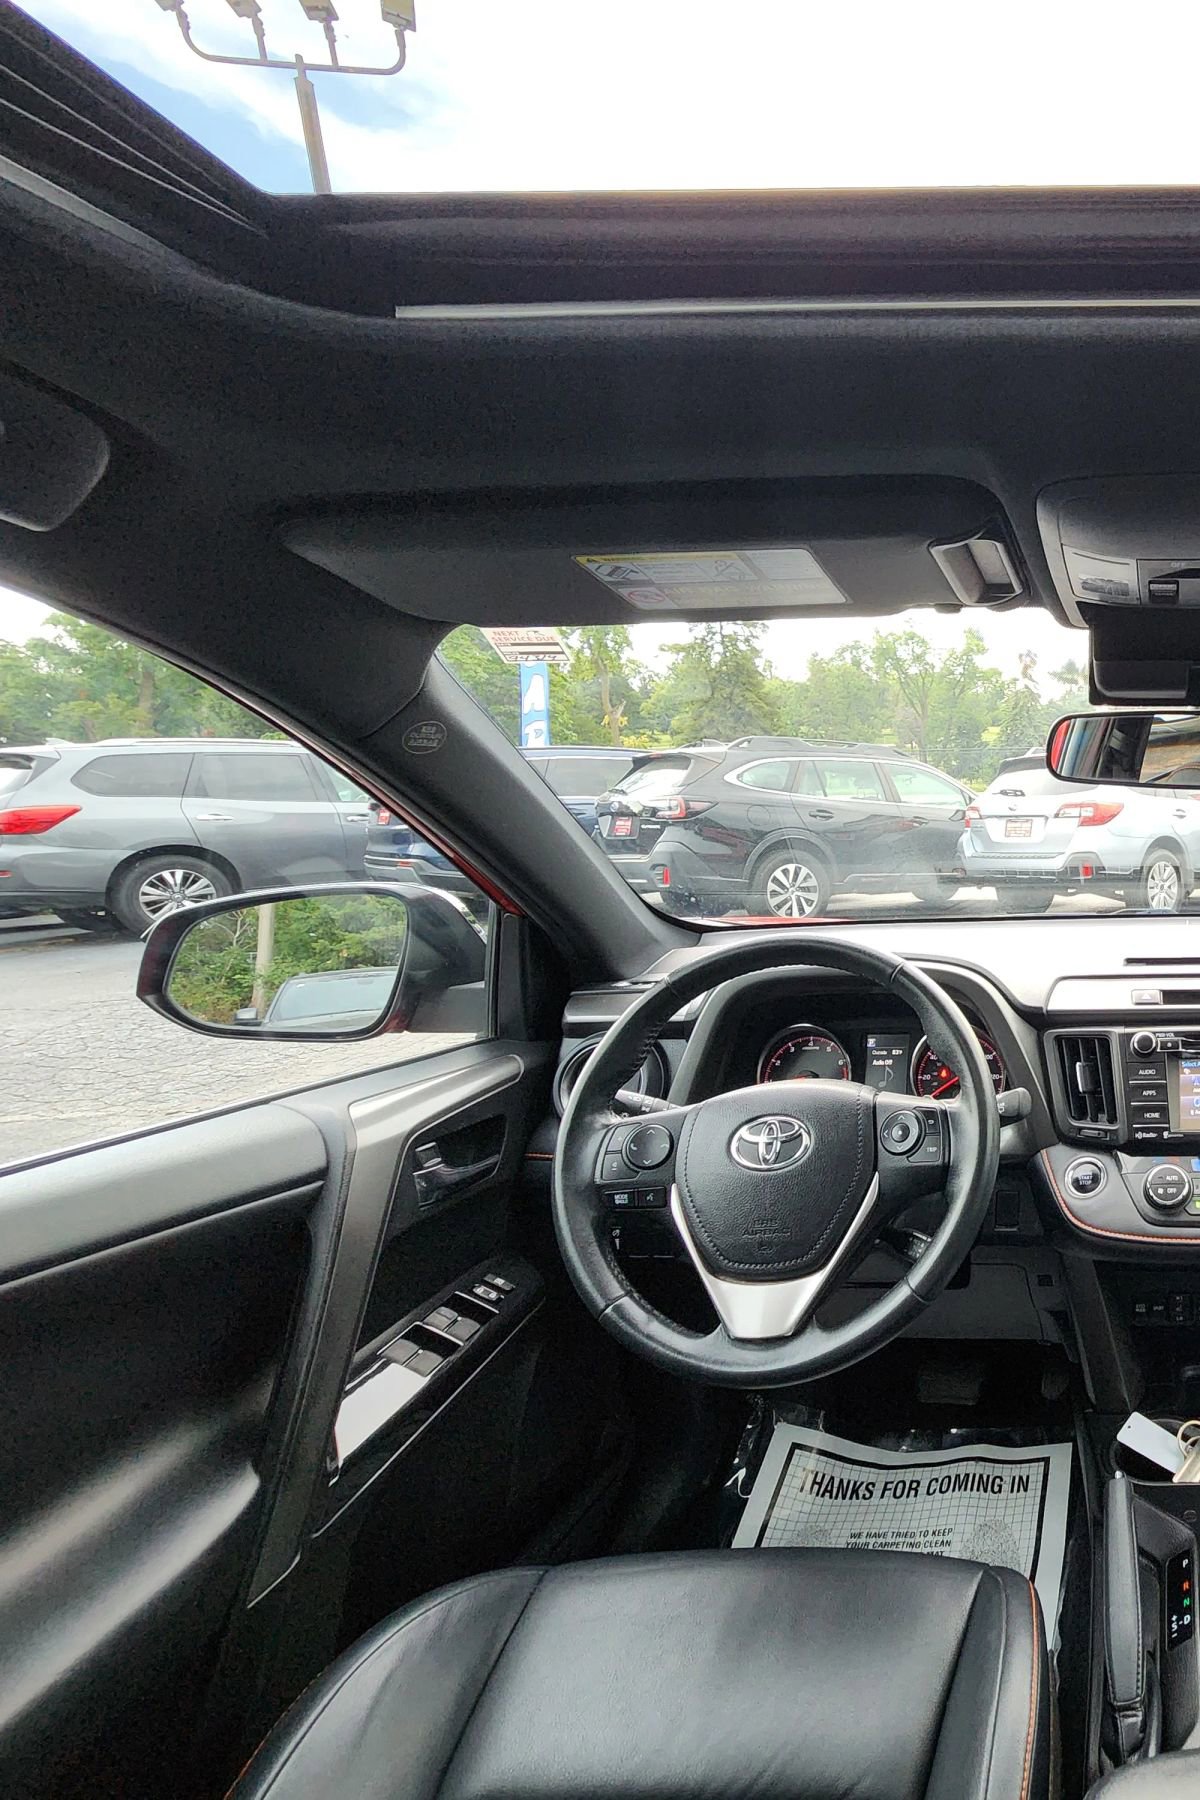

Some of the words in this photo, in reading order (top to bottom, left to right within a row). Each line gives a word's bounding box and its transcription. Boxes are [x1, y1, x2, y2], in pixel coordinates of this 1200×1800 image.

[799, 1467, 877, 1501] THANKS
[879, 1479, 921, 1500] FOR
[925, 1472, 1004, 1496] COMING
[1009, 1474, 1030, 1494] IN
[849, 1531, 864, 1539] WE
[865, 1531, 889, 1539] HAVE
[890, 1531, 916, 1539] TRIED
[931, 1527, 953, 1537] KEEP
[846, 1541, 870, 1549] YOUR
[872, 1541, 922, 1549] CARPETING
[923, 1539, 952, 1549] CLEAN
[1182, 1558, 1189, 1568] P
[1183, 1580, 1190, 1591] R
[1183, 1597, 1190, 1607] N
[1183, 1614, 1191, 1625] D
[1171, 1621, 1178, 1632] S
